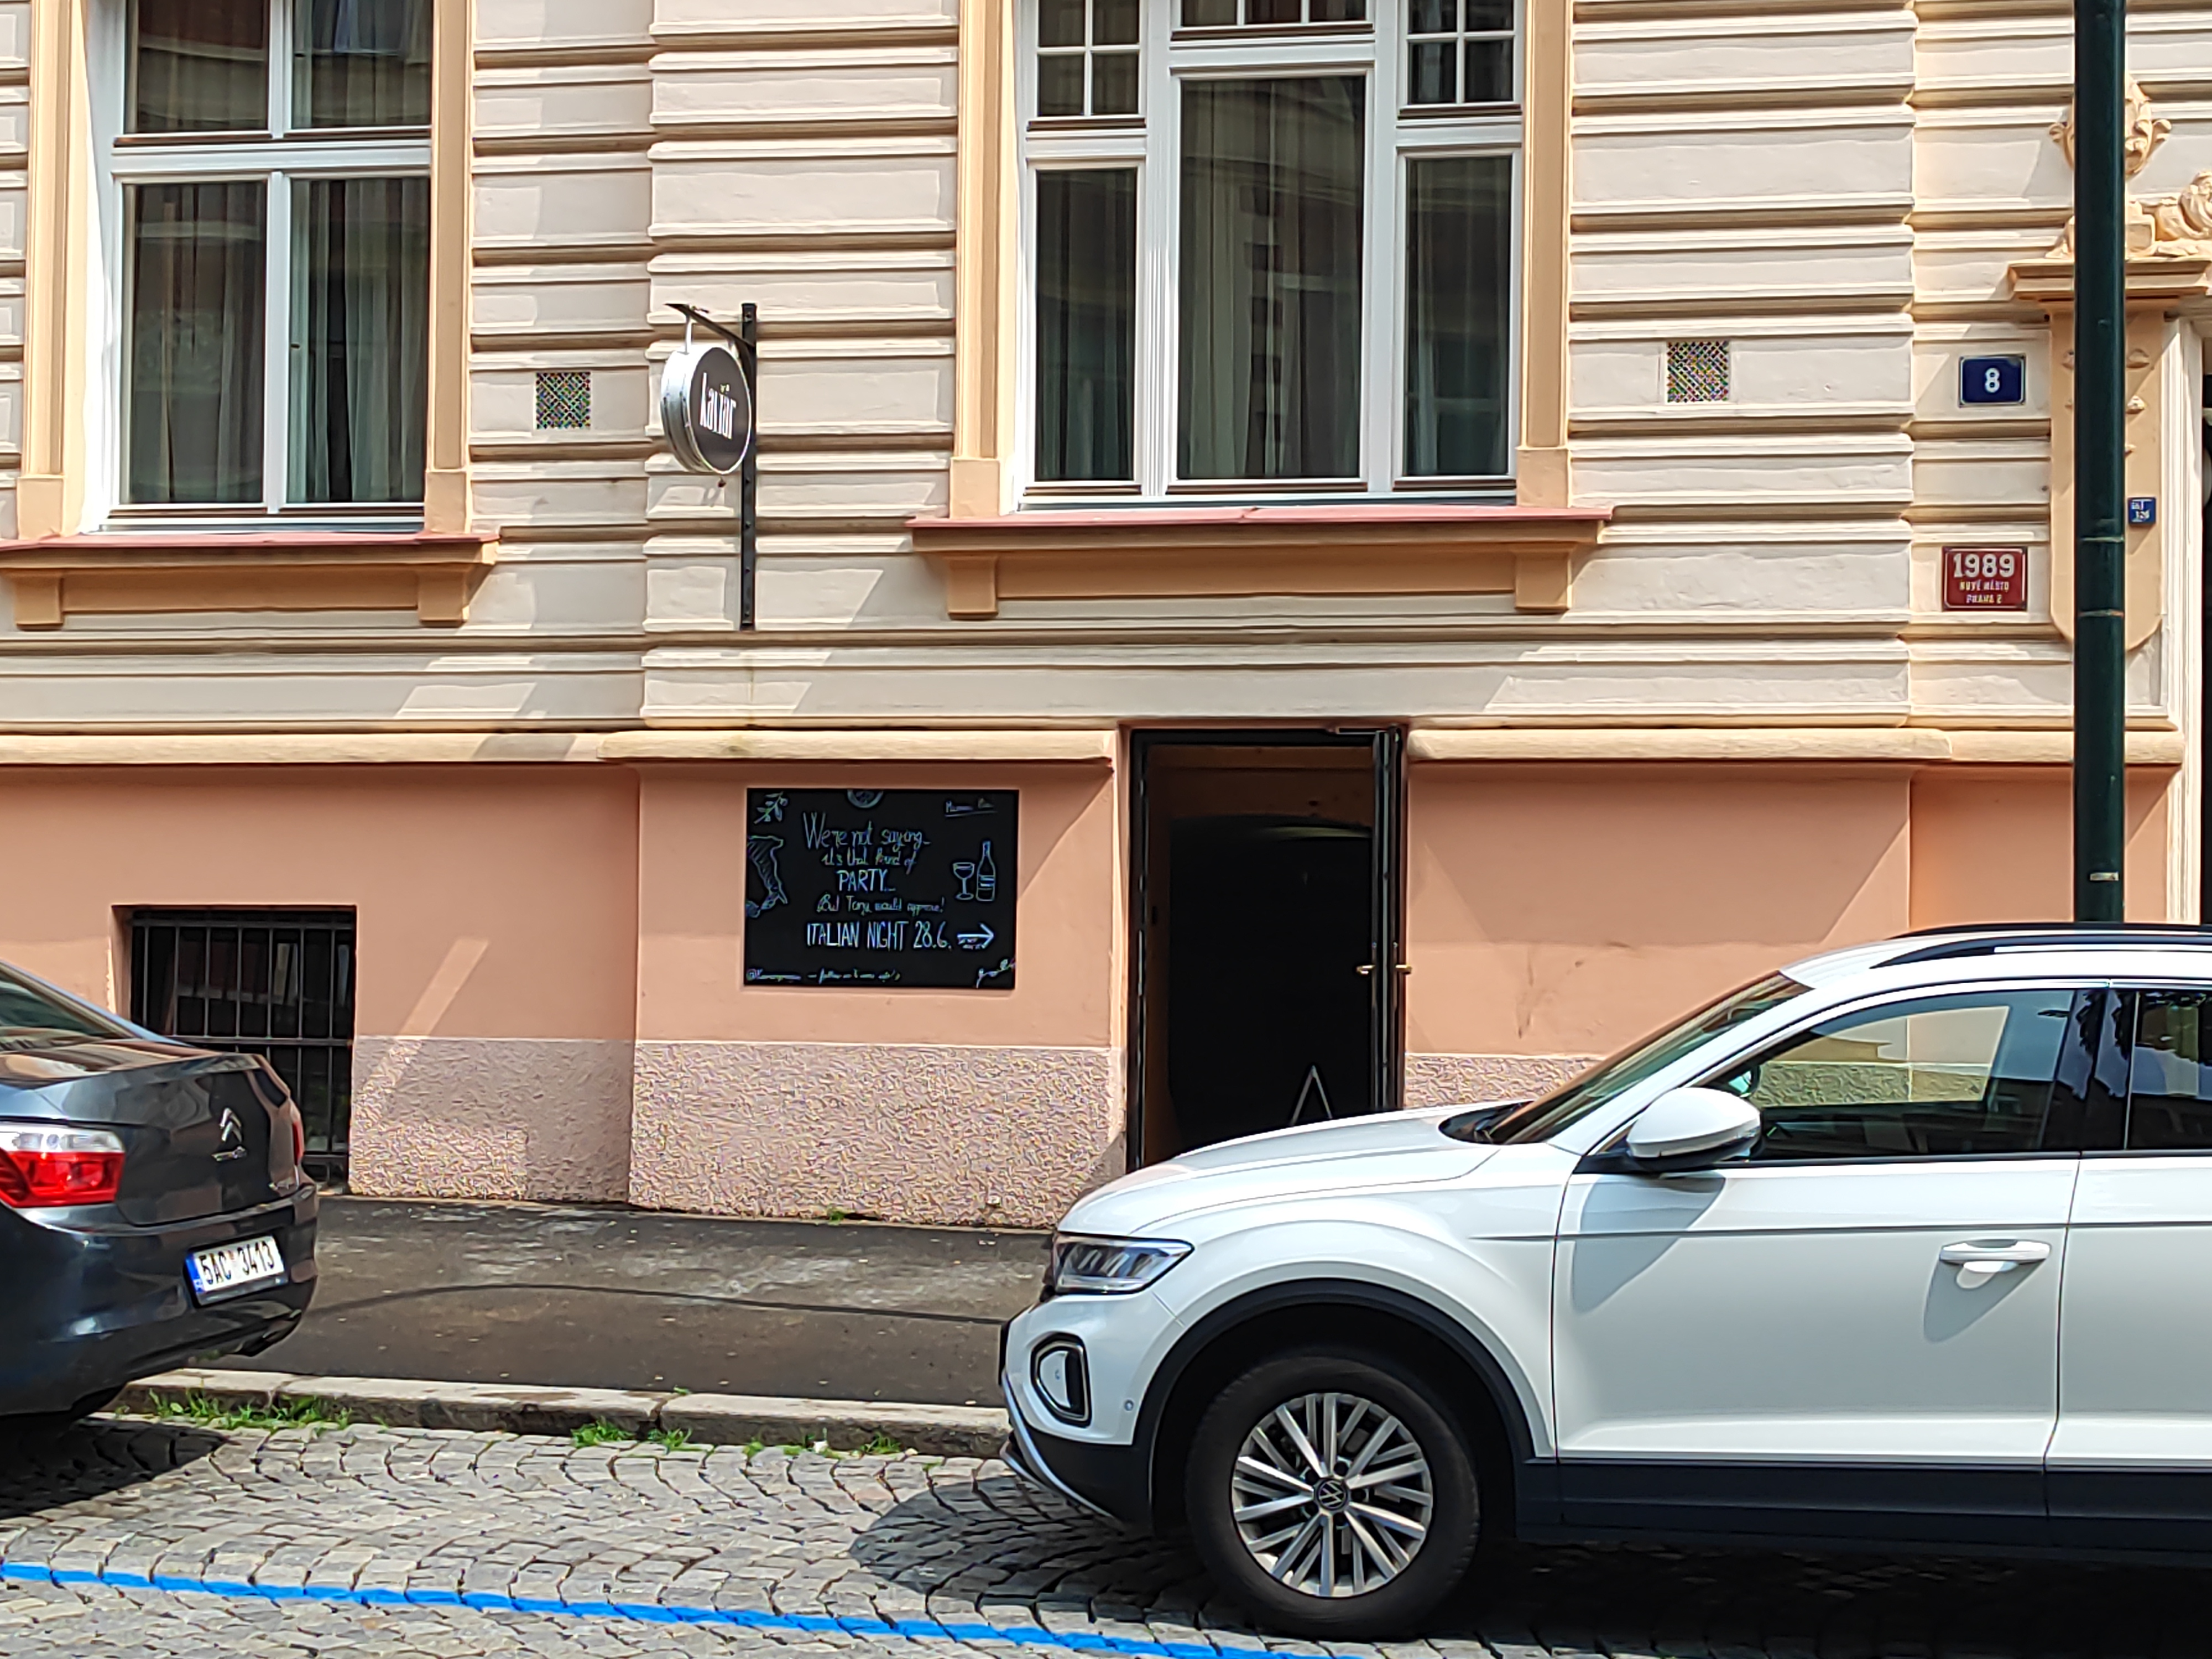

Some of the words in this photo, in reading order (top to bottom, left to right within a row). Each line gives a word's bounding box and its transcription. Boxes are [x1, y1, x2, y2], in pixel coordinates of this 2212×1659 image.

[1984, 367, 2000, 394] 8
[1953, 553, 2015, 578] 1989
[1996, 594, 2002, 604] 2
[851, 821, 873, 848] not
[847, 846, 869, 867] that
[903, 850, 917, 875] of
[846, 895, 873, 916] Tony
[874, 897, 902, 911] would
[807, 921, 860, 948] ITALIAN
[867, 920, 910, 952] NIGHT
[199, 1250, 232, 1285] 5AC
[237, 1240, 274, 1276] 3413
